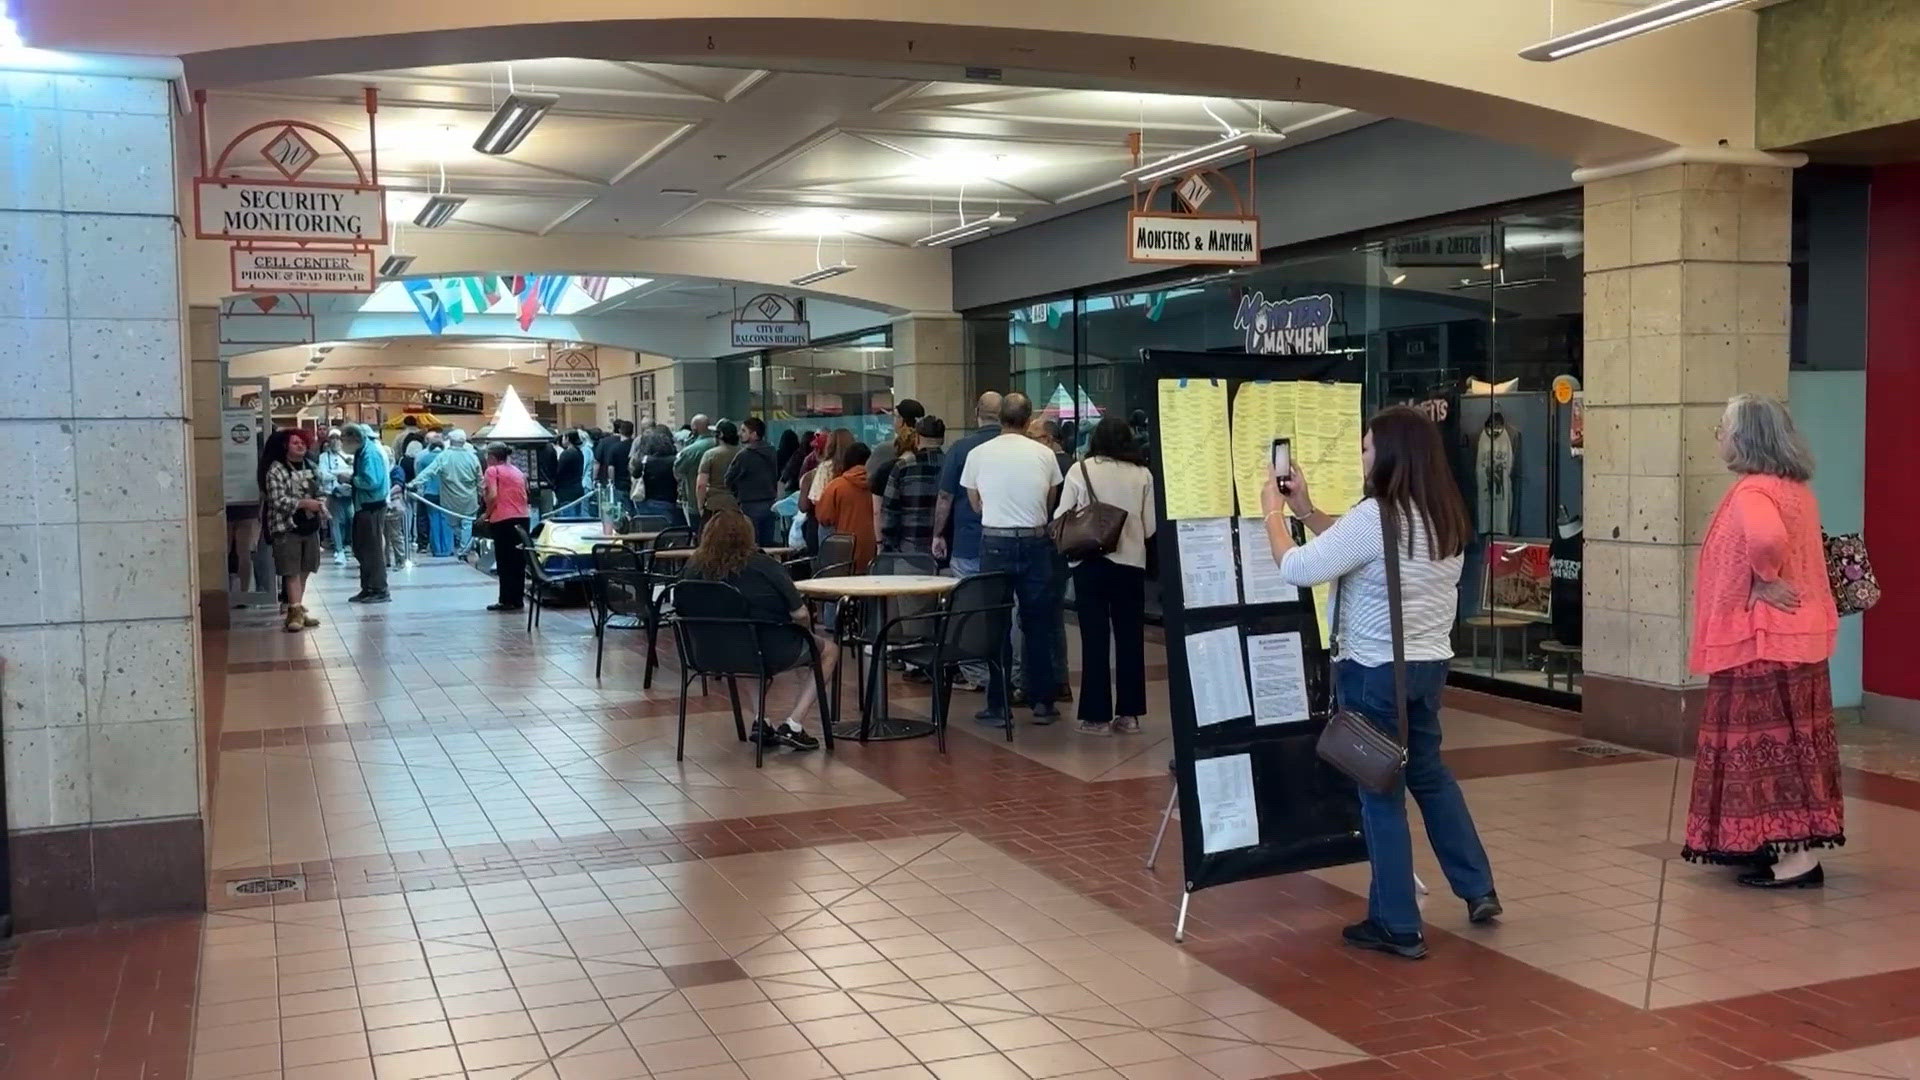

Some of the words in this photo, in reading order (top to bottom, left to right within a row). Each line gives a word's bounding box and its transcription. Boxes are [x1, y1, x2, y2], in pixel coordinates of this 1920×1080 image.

[239, 190, 344, 211] SECURITY
[224, 211, 362, 233] MONITORING
[1136, 227, 1190, 250] MONSTERS
[1194, 236, 1204, 250] &
[1208, 230, 1253, 251] MAYHEM
[254, 256, 291, 269] CELL
[293, 257, 350, 270] CENTER
[241, 271, 282, 280] PHONE
[283, 271, 293, 280] &
[324, 272, 366, 282] REPAIR
[756, 325, 773, 333] CITY
[774, 325, 784, 333] OF
[735, 335, 774, 343] BALCONES
[774, 335, 806, 343] HEIGHTS
[1263, 326, 1325, 355] MAYHEM
